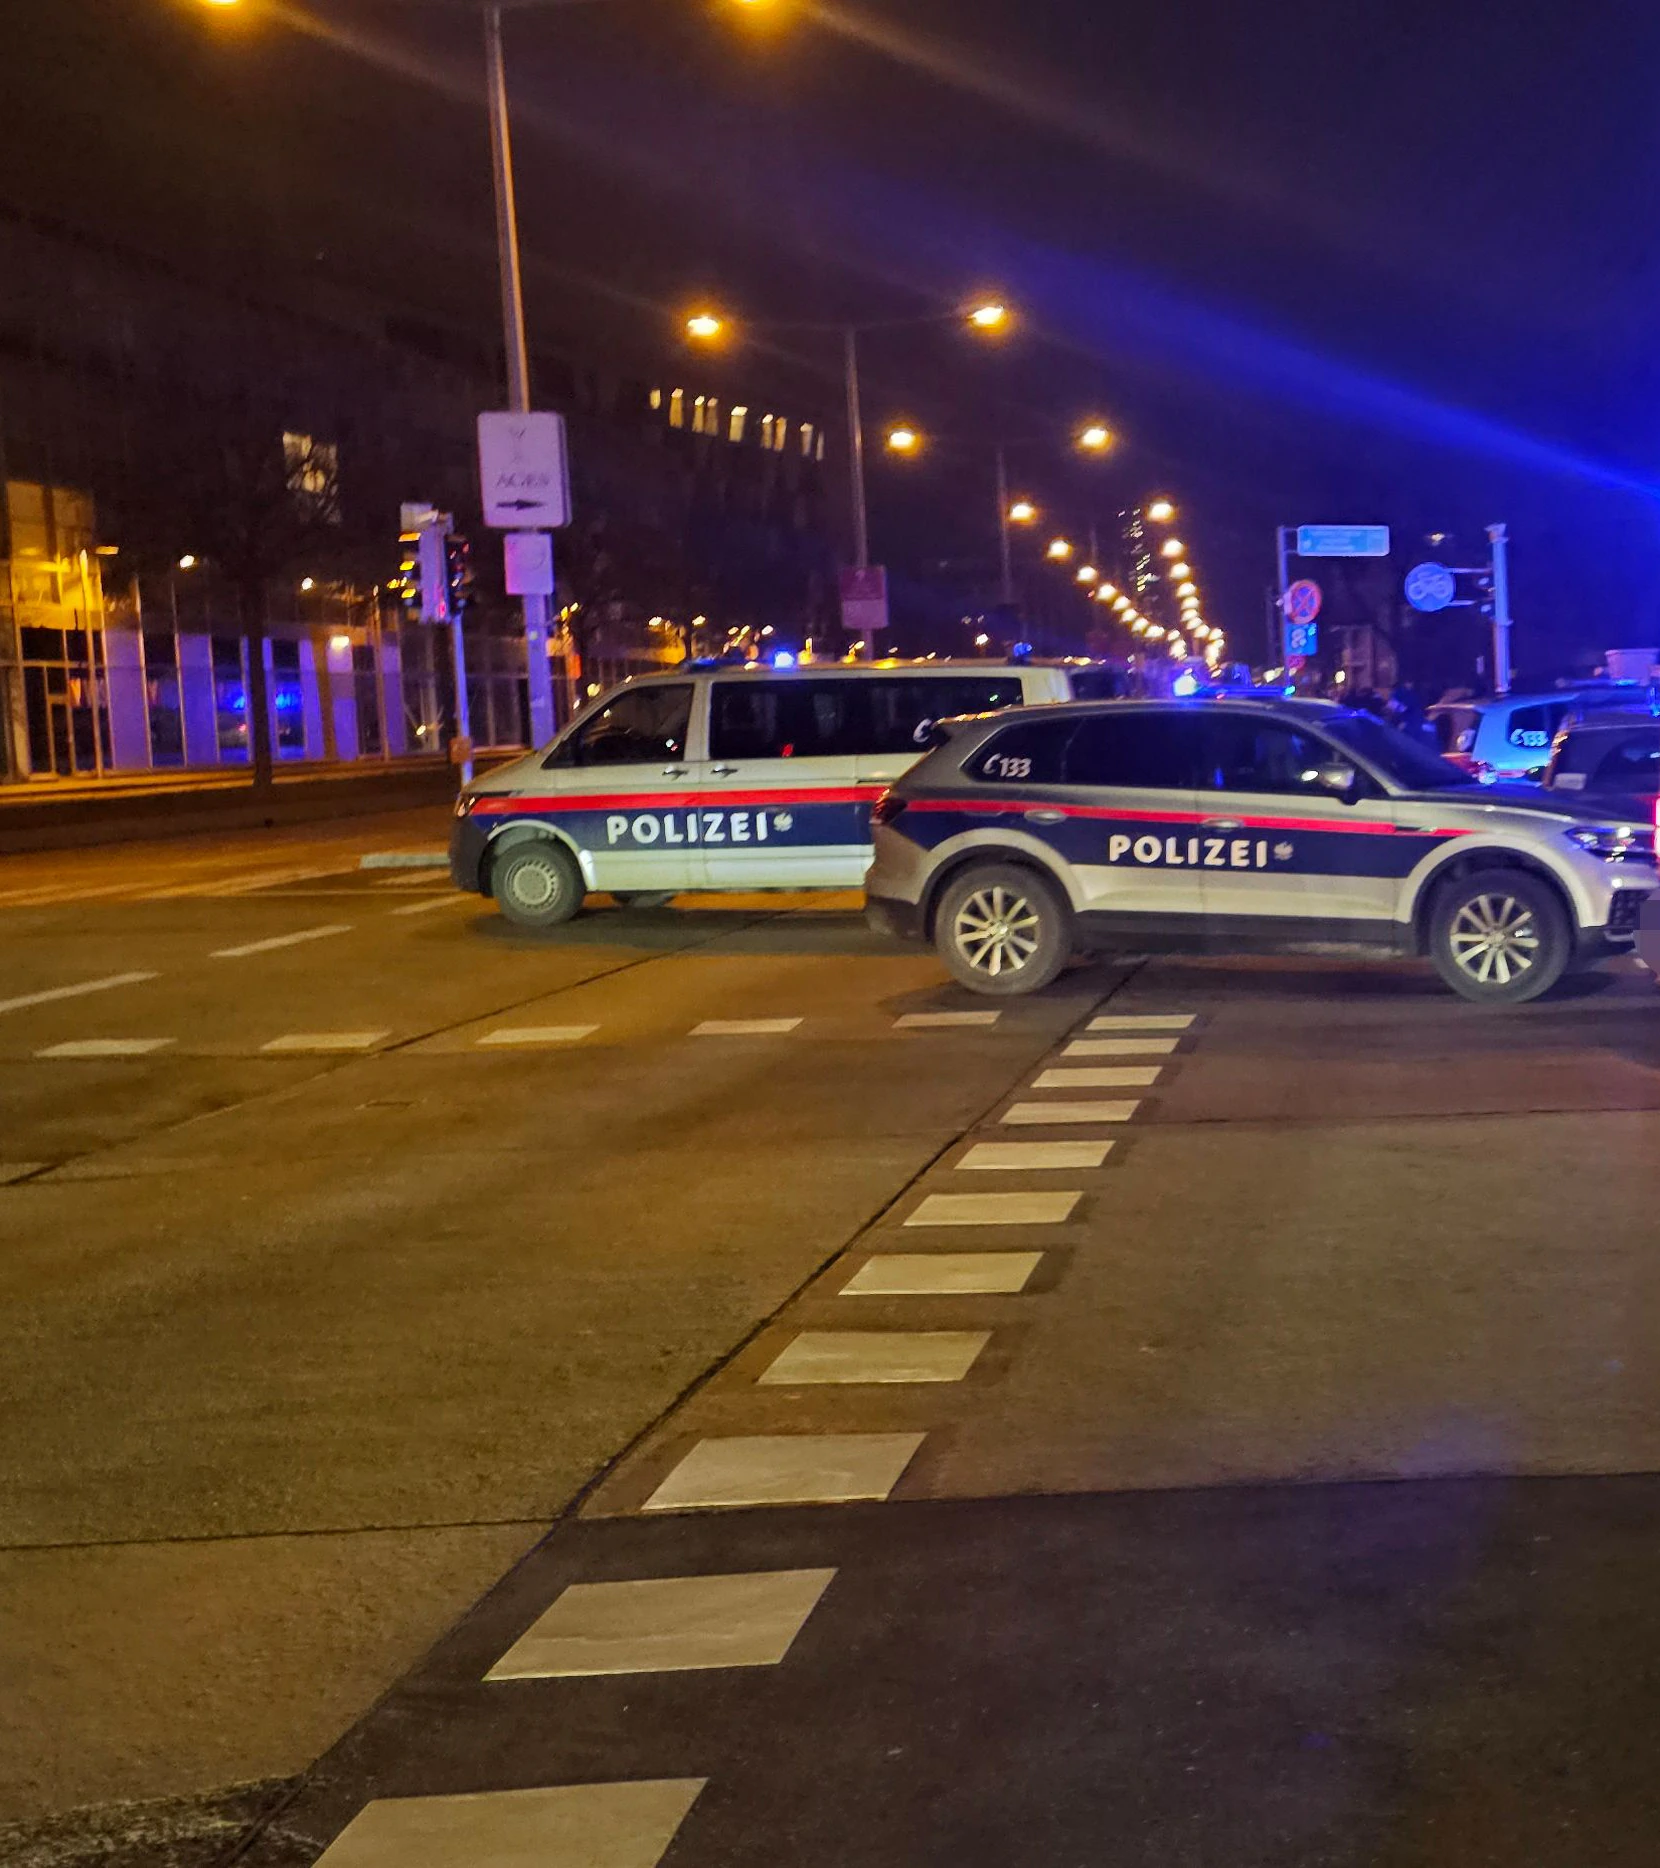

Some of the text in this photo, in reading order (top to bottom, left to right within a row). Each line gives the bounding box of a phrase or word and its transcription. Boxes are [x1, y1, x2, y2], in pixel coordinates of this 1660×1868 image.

[1000, 757, 1032, 778] 133
[606, 811, 768, 845] POLIZEI
[1109, 834, 1267, 868] POLIZEI
